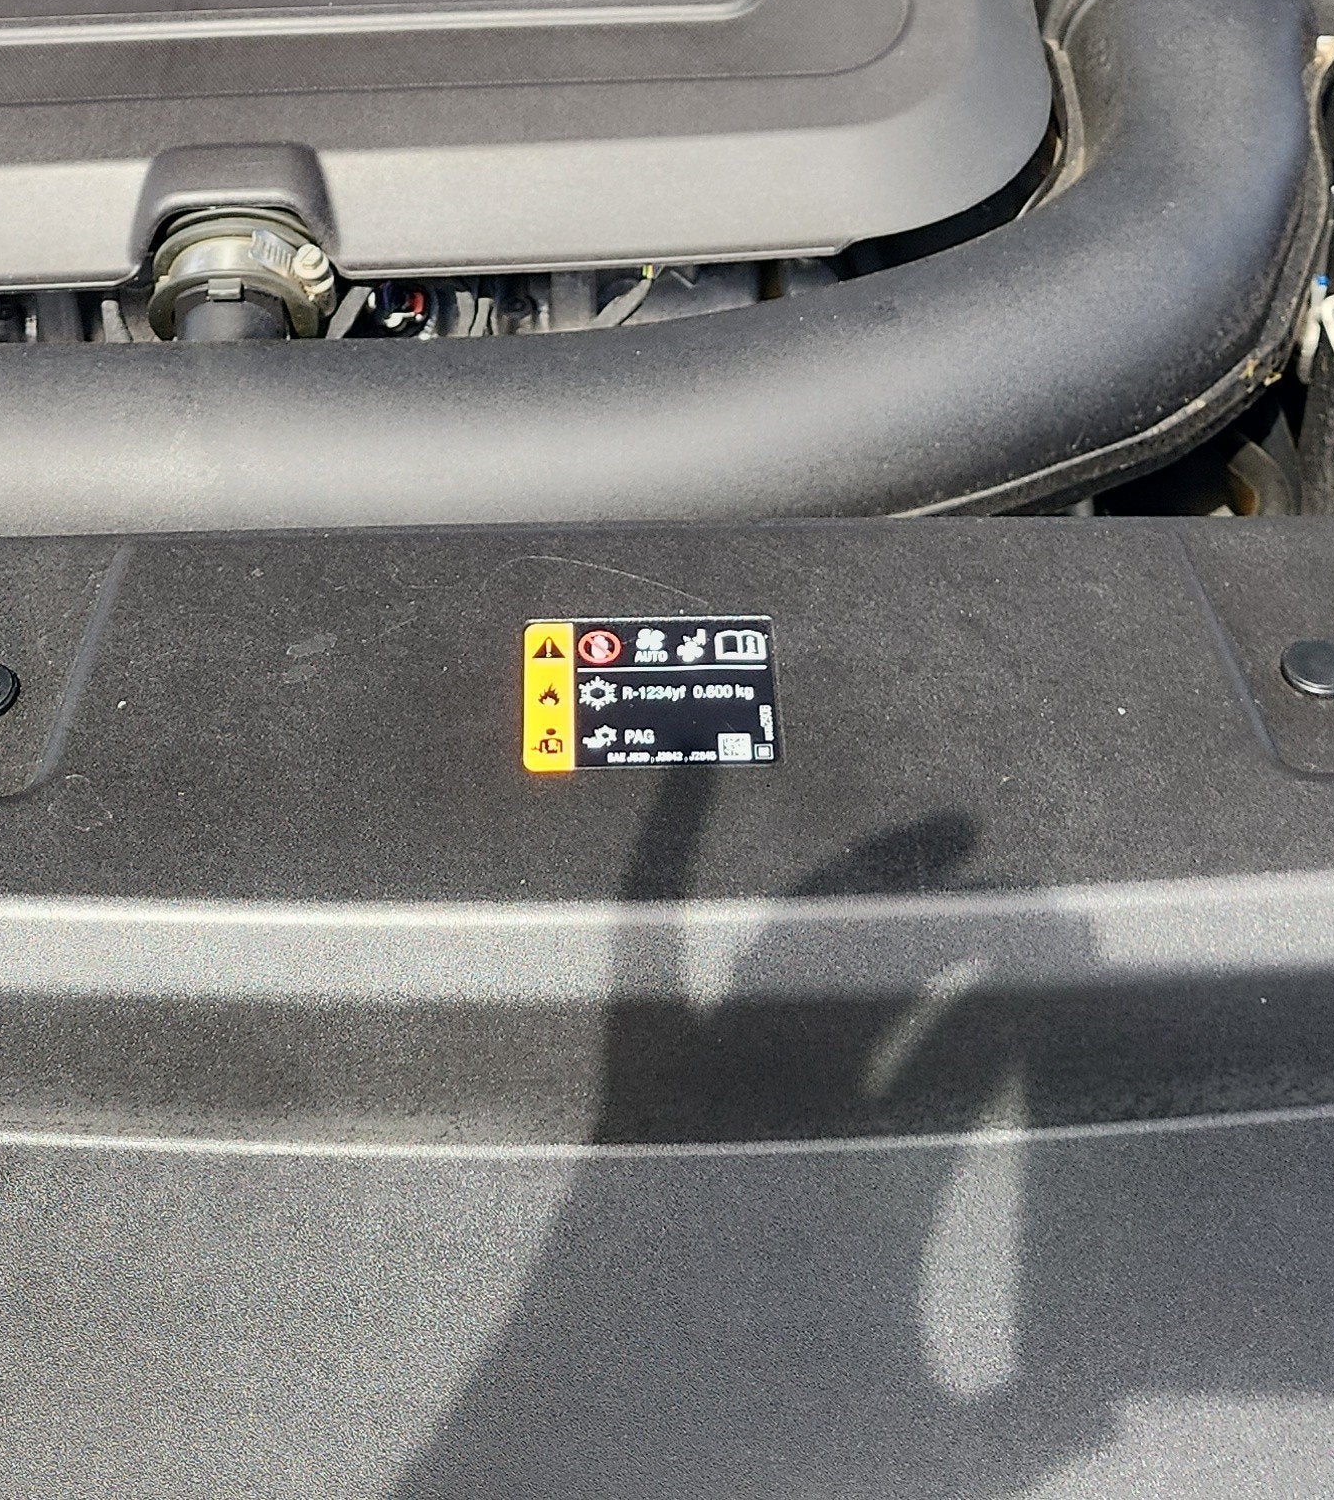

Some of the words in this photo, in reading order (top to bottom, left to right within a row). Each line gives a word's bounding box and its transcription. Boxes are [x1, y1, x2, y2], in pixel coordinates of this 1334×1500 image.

[634, 651, 668, 663] AUTO
[622, 685, 687, 701] R-1234yf
[735, 683, 754, 700] kg
[624, 728, 655, 745] PAG
